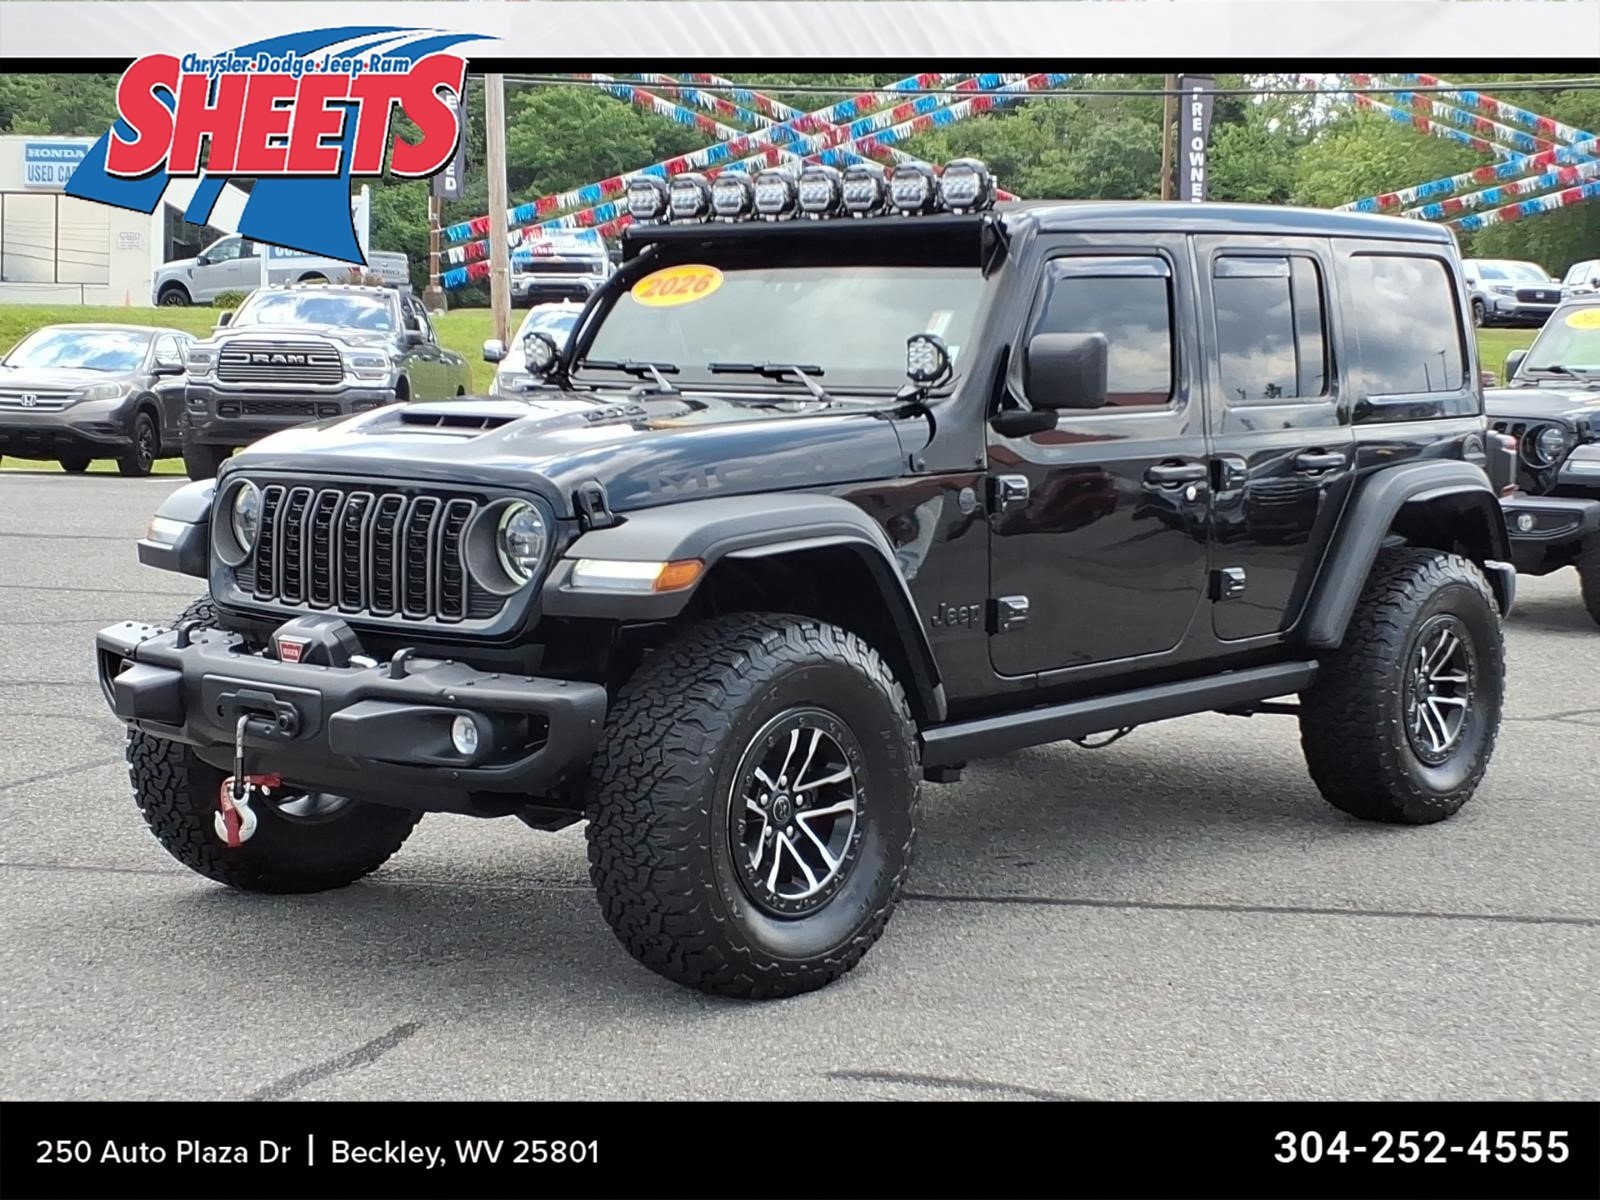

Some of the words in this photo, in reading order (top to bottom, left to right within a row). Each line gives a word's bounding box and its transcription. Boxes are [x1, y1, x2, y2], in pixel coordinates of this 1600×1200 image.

[28, 148, 86, 158] HONDA
[27, 164, 54, 182] USED
[1189, 136, 1205, 203] OWNE
[641, 273, 714, 297] 2026
[252, 353, 305, 364] RAM
[931, 602, 980, 629] Jeep
